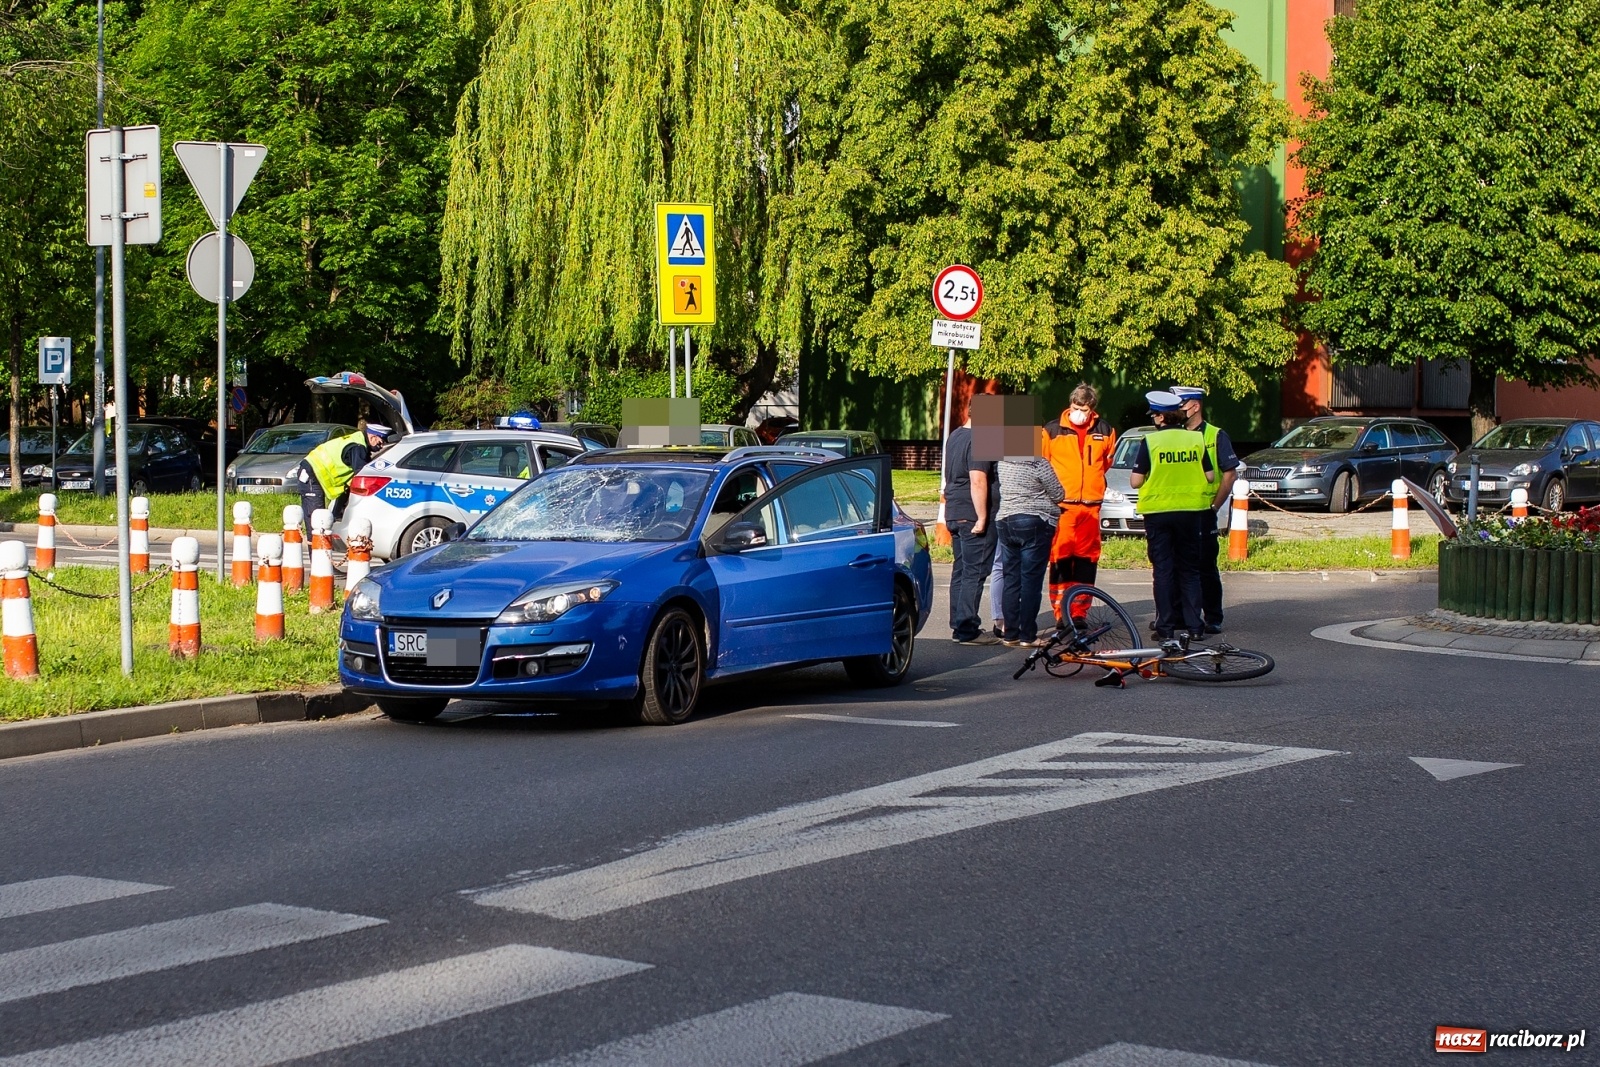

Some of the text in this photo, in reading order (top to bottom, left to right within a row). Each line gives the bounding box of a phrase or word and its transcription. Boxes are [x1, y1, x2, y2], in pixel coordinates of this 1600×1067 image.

[943, 279, 976, 302] 2,5t
[951, 322, 976, 332] dotyczy
[937, 330, 975, 339] mikrobusów
[46, 350, 63, 371] P
[1159, 450, 1198, 463] POLICJA
[385, 487, 412, 499] R528
[397, 634, 425, 652] SRC
